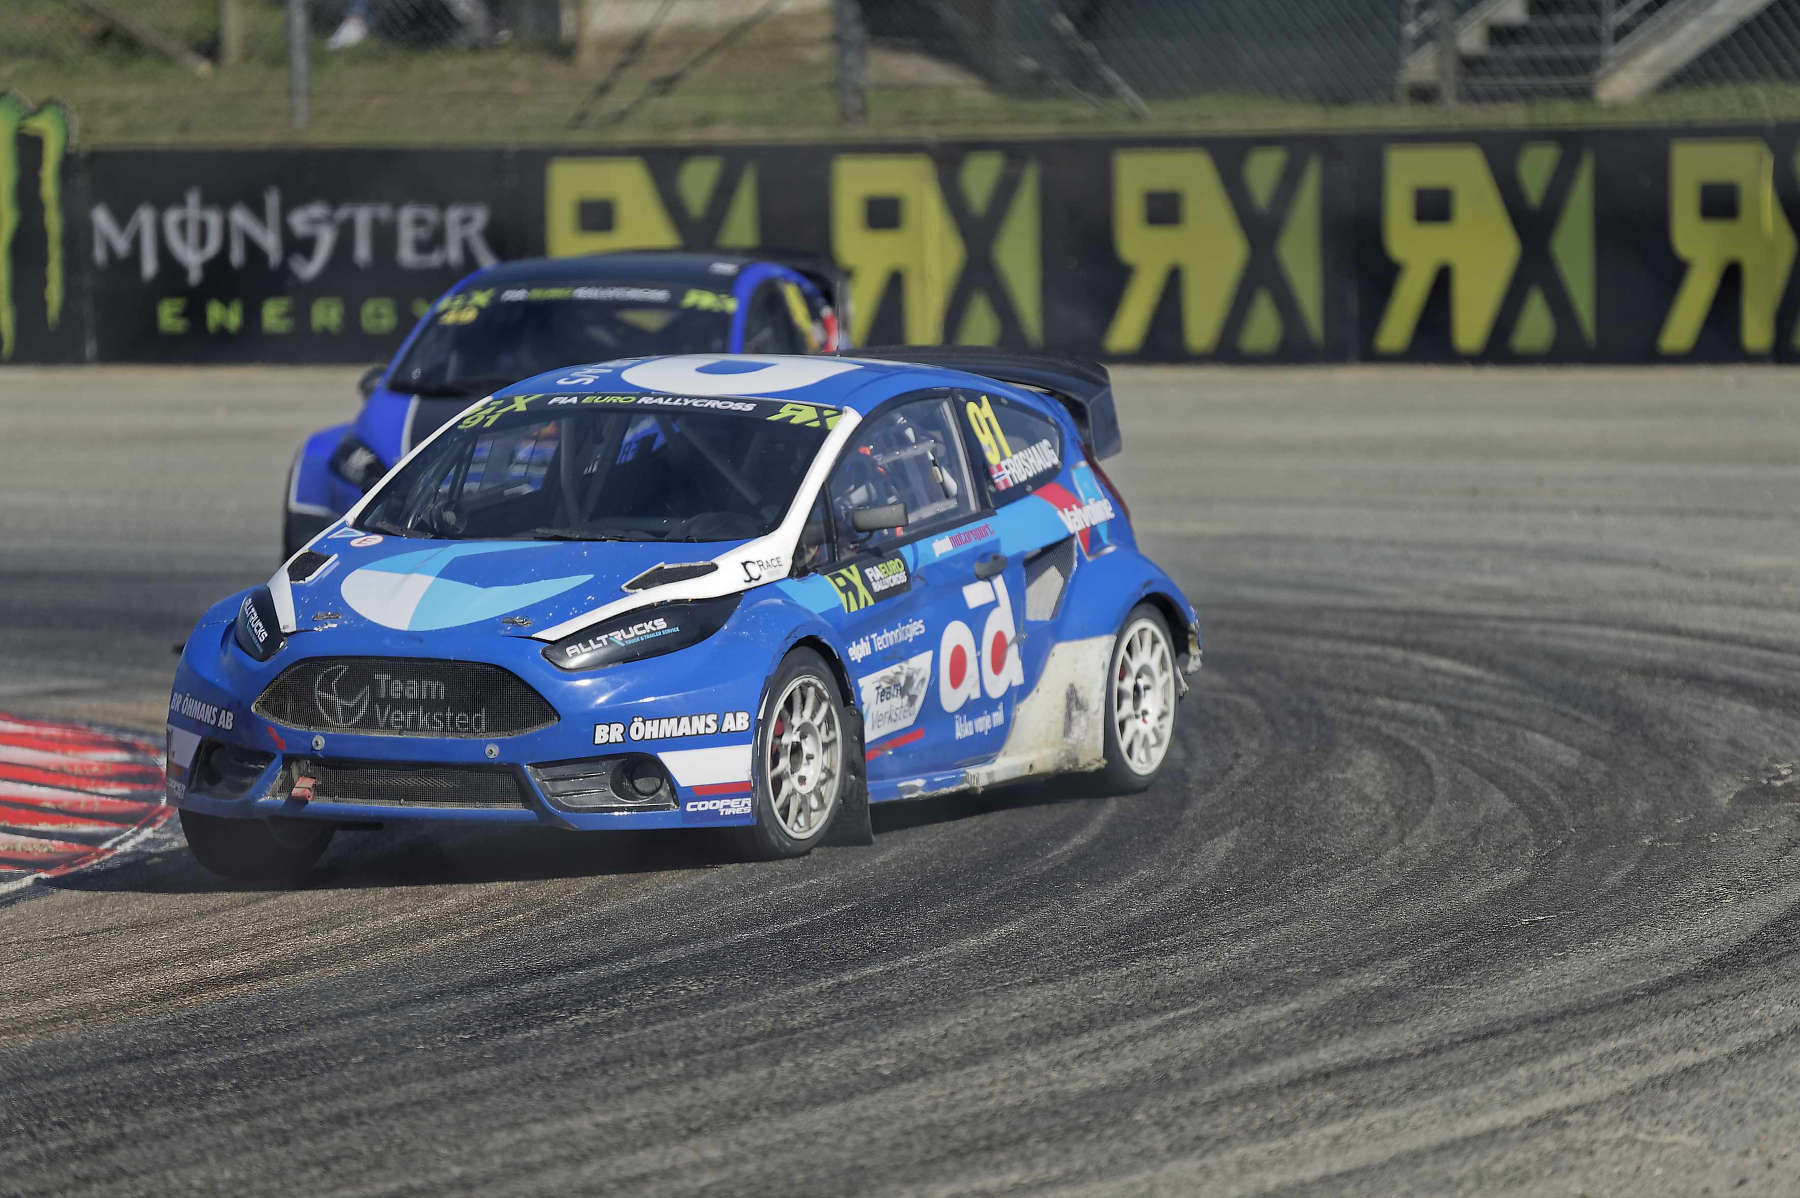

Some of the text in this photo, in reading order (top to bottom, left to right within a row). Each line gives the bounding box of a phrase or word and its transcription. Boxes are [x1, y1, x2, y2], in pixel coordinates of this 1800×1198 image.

[91, 186, 498, 286] MONSTER
[156, 297, 432, 334] ENERG
[458, 406, 503, 430] 91
[548, 395, 757, 412] FIA EURO RALLYCROSS
[966, 395, 1012, 465] 91
[756, 556, 783, 571] RACE
[565, 617, 668, 658] ALLTRUCKS
[870, 618, 926, 652] Technologies
[374, 673, 445, 699] Team
[171, 692, 234, 730] BR ÖHMANS AB
[375, 703, 486, 732] Verksted
[594, 711, 750, 745] BR ÖHMANS AB
[686, 797, 752, 812] COOPER
[719, 806, 752, 816] TIRES
